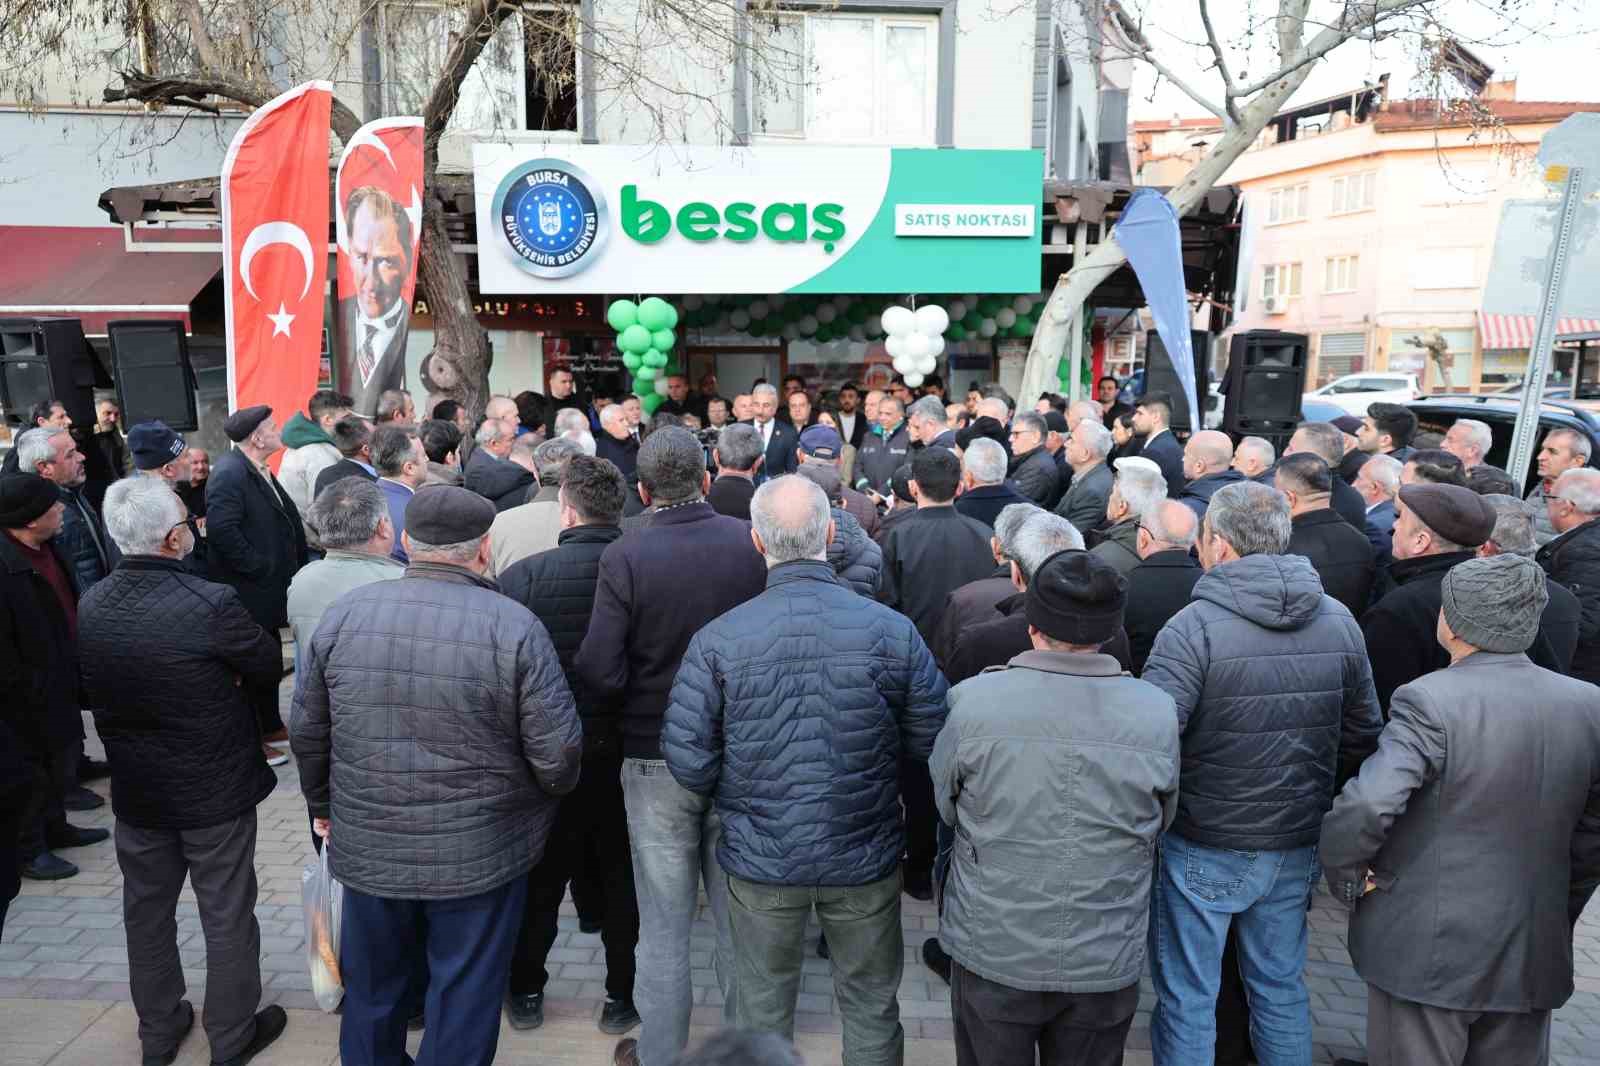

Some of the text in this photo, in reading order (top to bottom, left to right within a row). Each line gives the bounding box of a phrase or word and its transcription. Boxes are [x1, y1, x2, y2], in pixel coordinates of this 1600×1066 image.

[526, 171, 569, 187] BURSA
[620, 184, 846, 254] besaş
[904, 213, 1027, 229] SATIŞ NOKTASI
[558, 212, 595, 264] BELEDİYESİ
